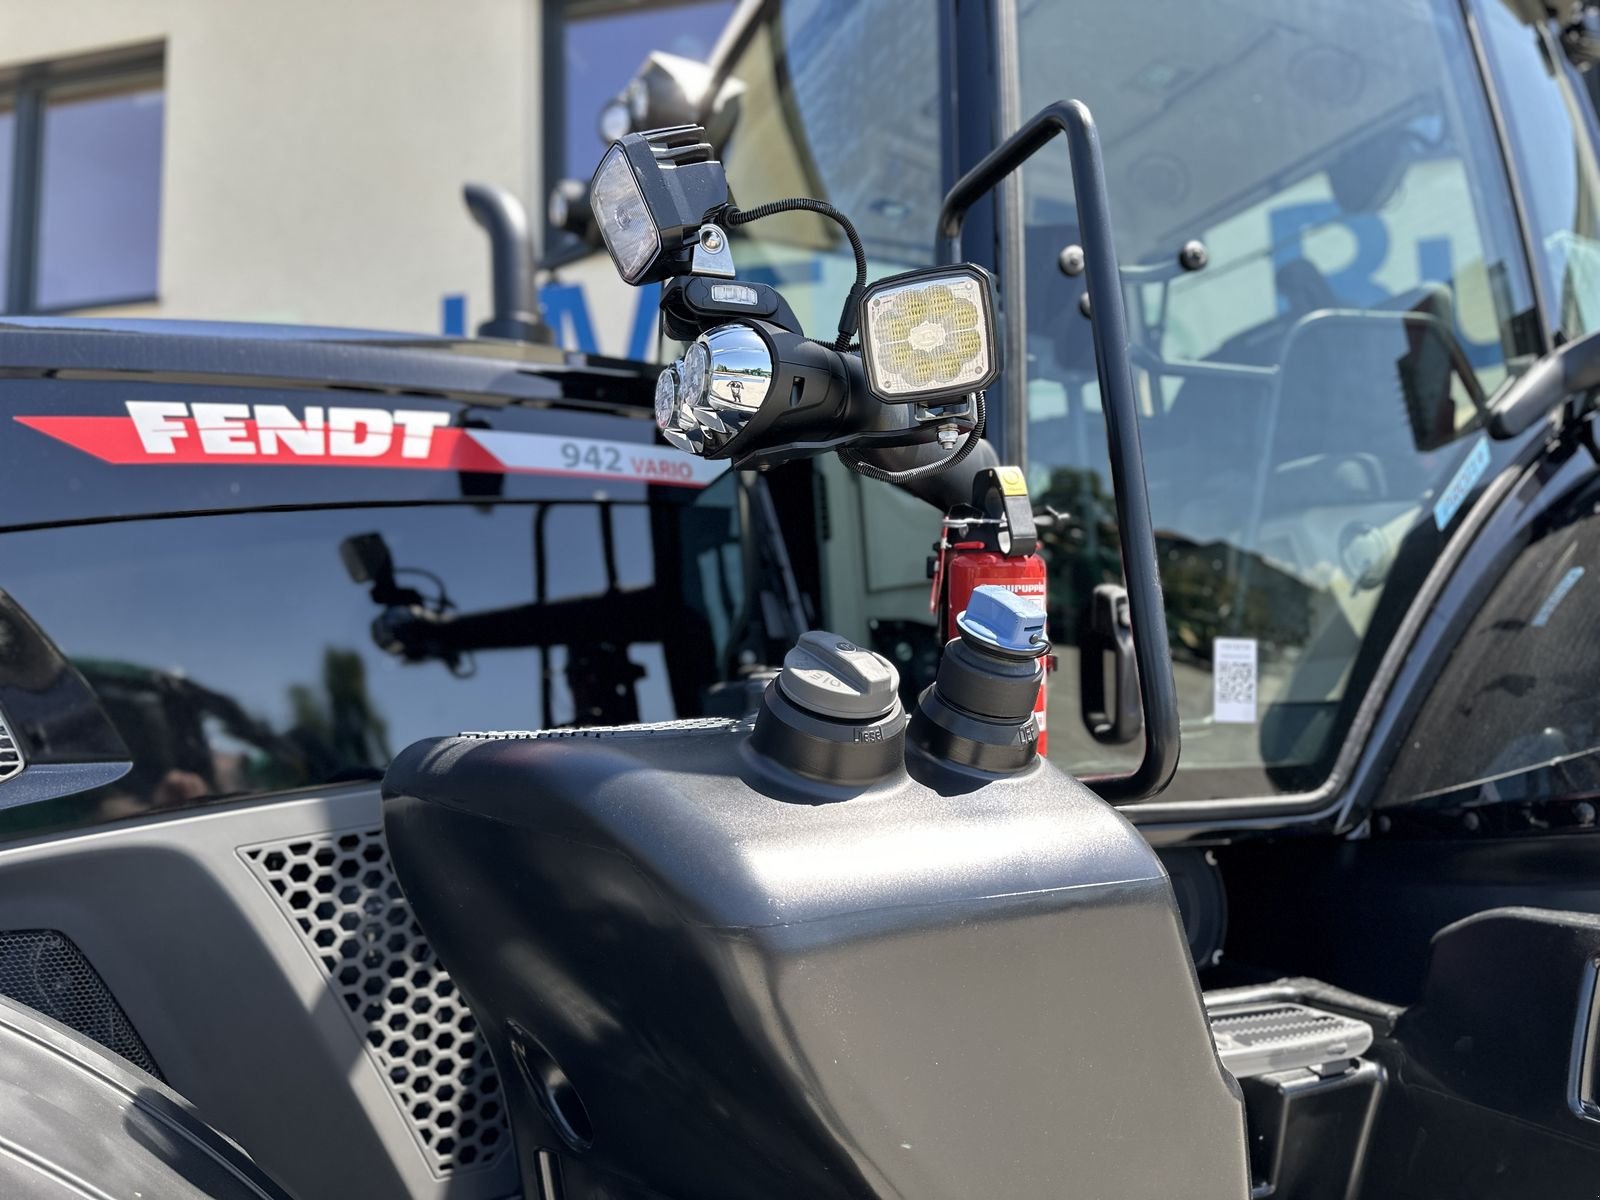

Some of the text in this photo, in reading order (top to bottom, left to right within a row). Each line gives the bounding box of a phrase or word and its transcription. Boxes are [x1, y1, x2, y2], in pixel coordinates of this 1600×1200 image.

[125, 400, 693, 480] FENDT 942 VARIO
